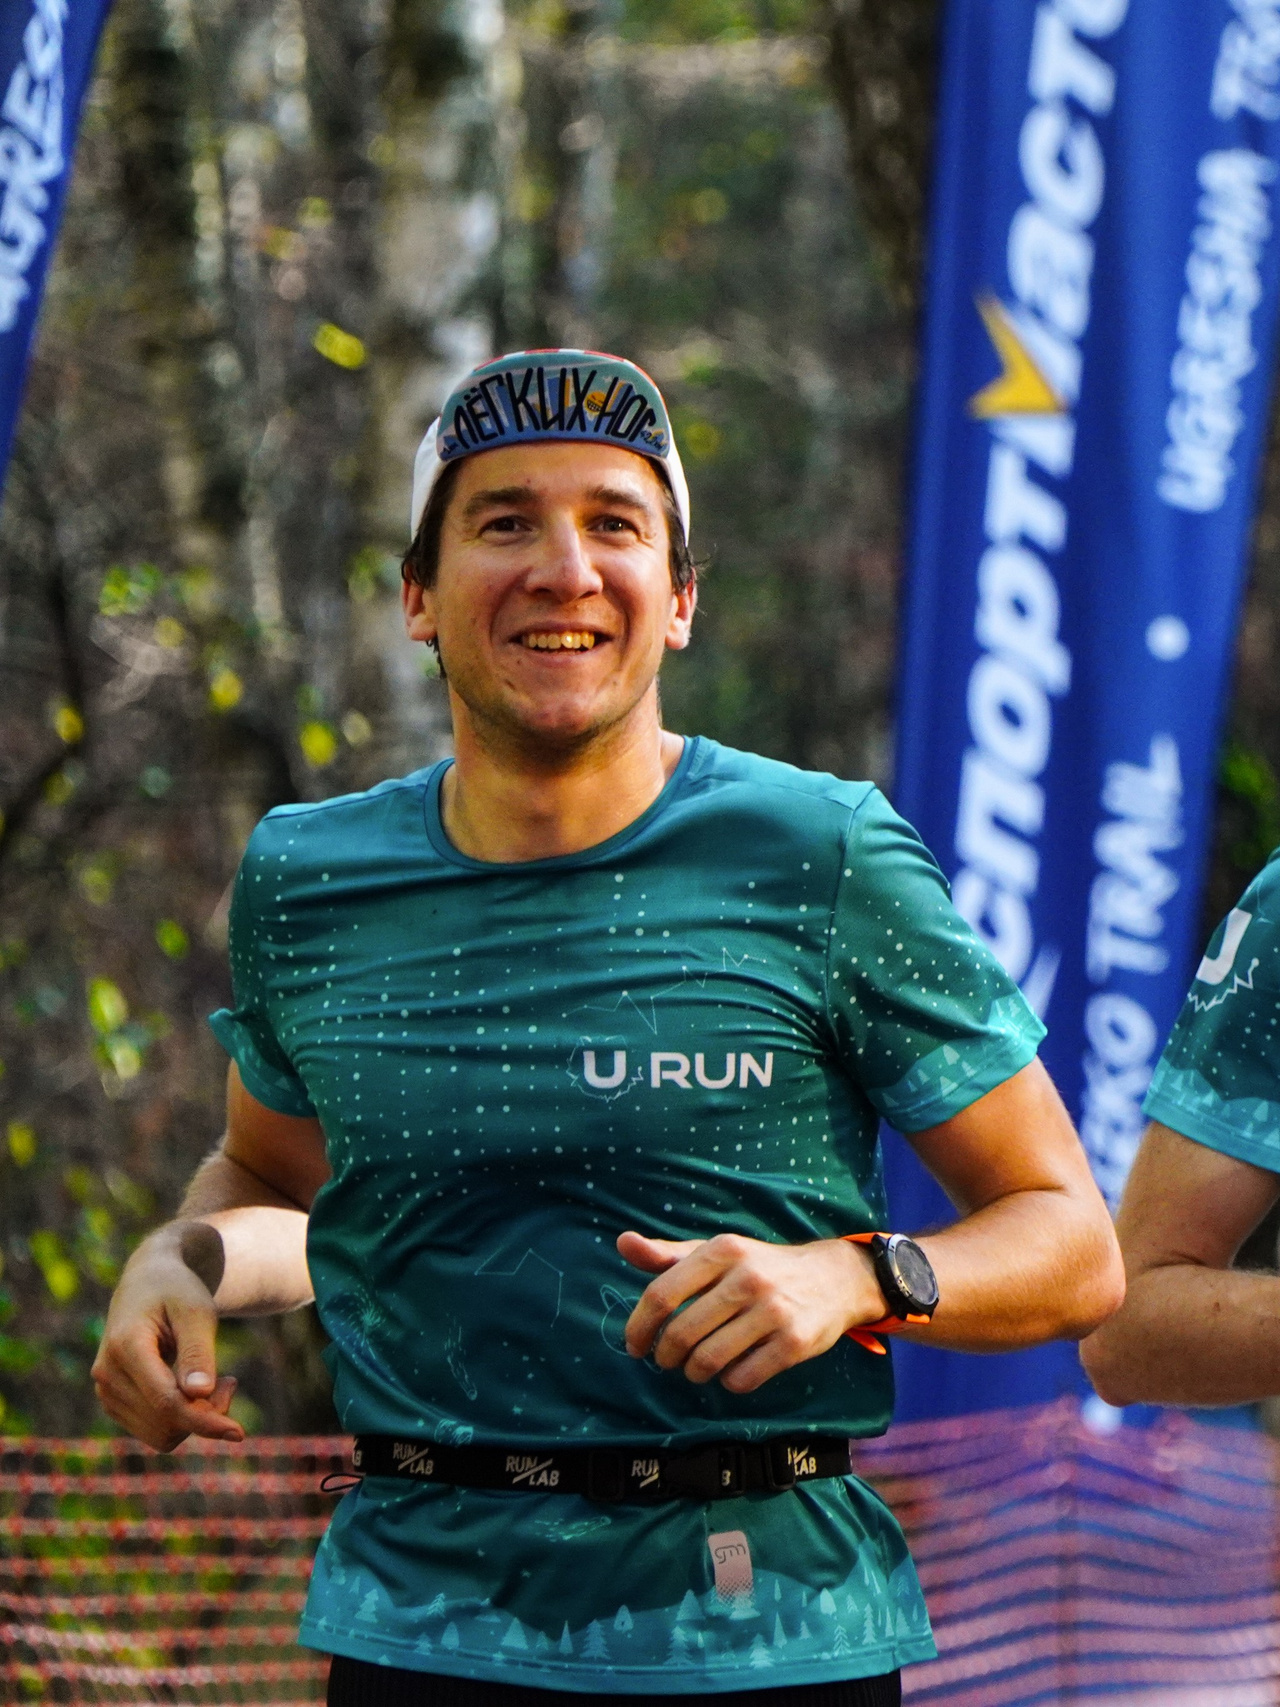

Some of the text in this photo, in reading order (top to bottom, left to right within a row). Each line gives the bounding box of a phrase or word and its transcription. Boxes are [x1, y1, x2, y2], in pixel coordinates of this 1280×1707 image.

[1085, 733, 1184, 984] TRAIL
[1156, 148, 1279, 513] UGRESHA
[583, 1050, 774, 1089] U RUN
[392, 1442, 417, 1460] RUN
[409, 1459, 434, 1476] LAB
[505, 1456, 538, 1473] RUN
[794, 1457, 817, 1476] LAB
[528, 1470, 561, 1487] LAB
